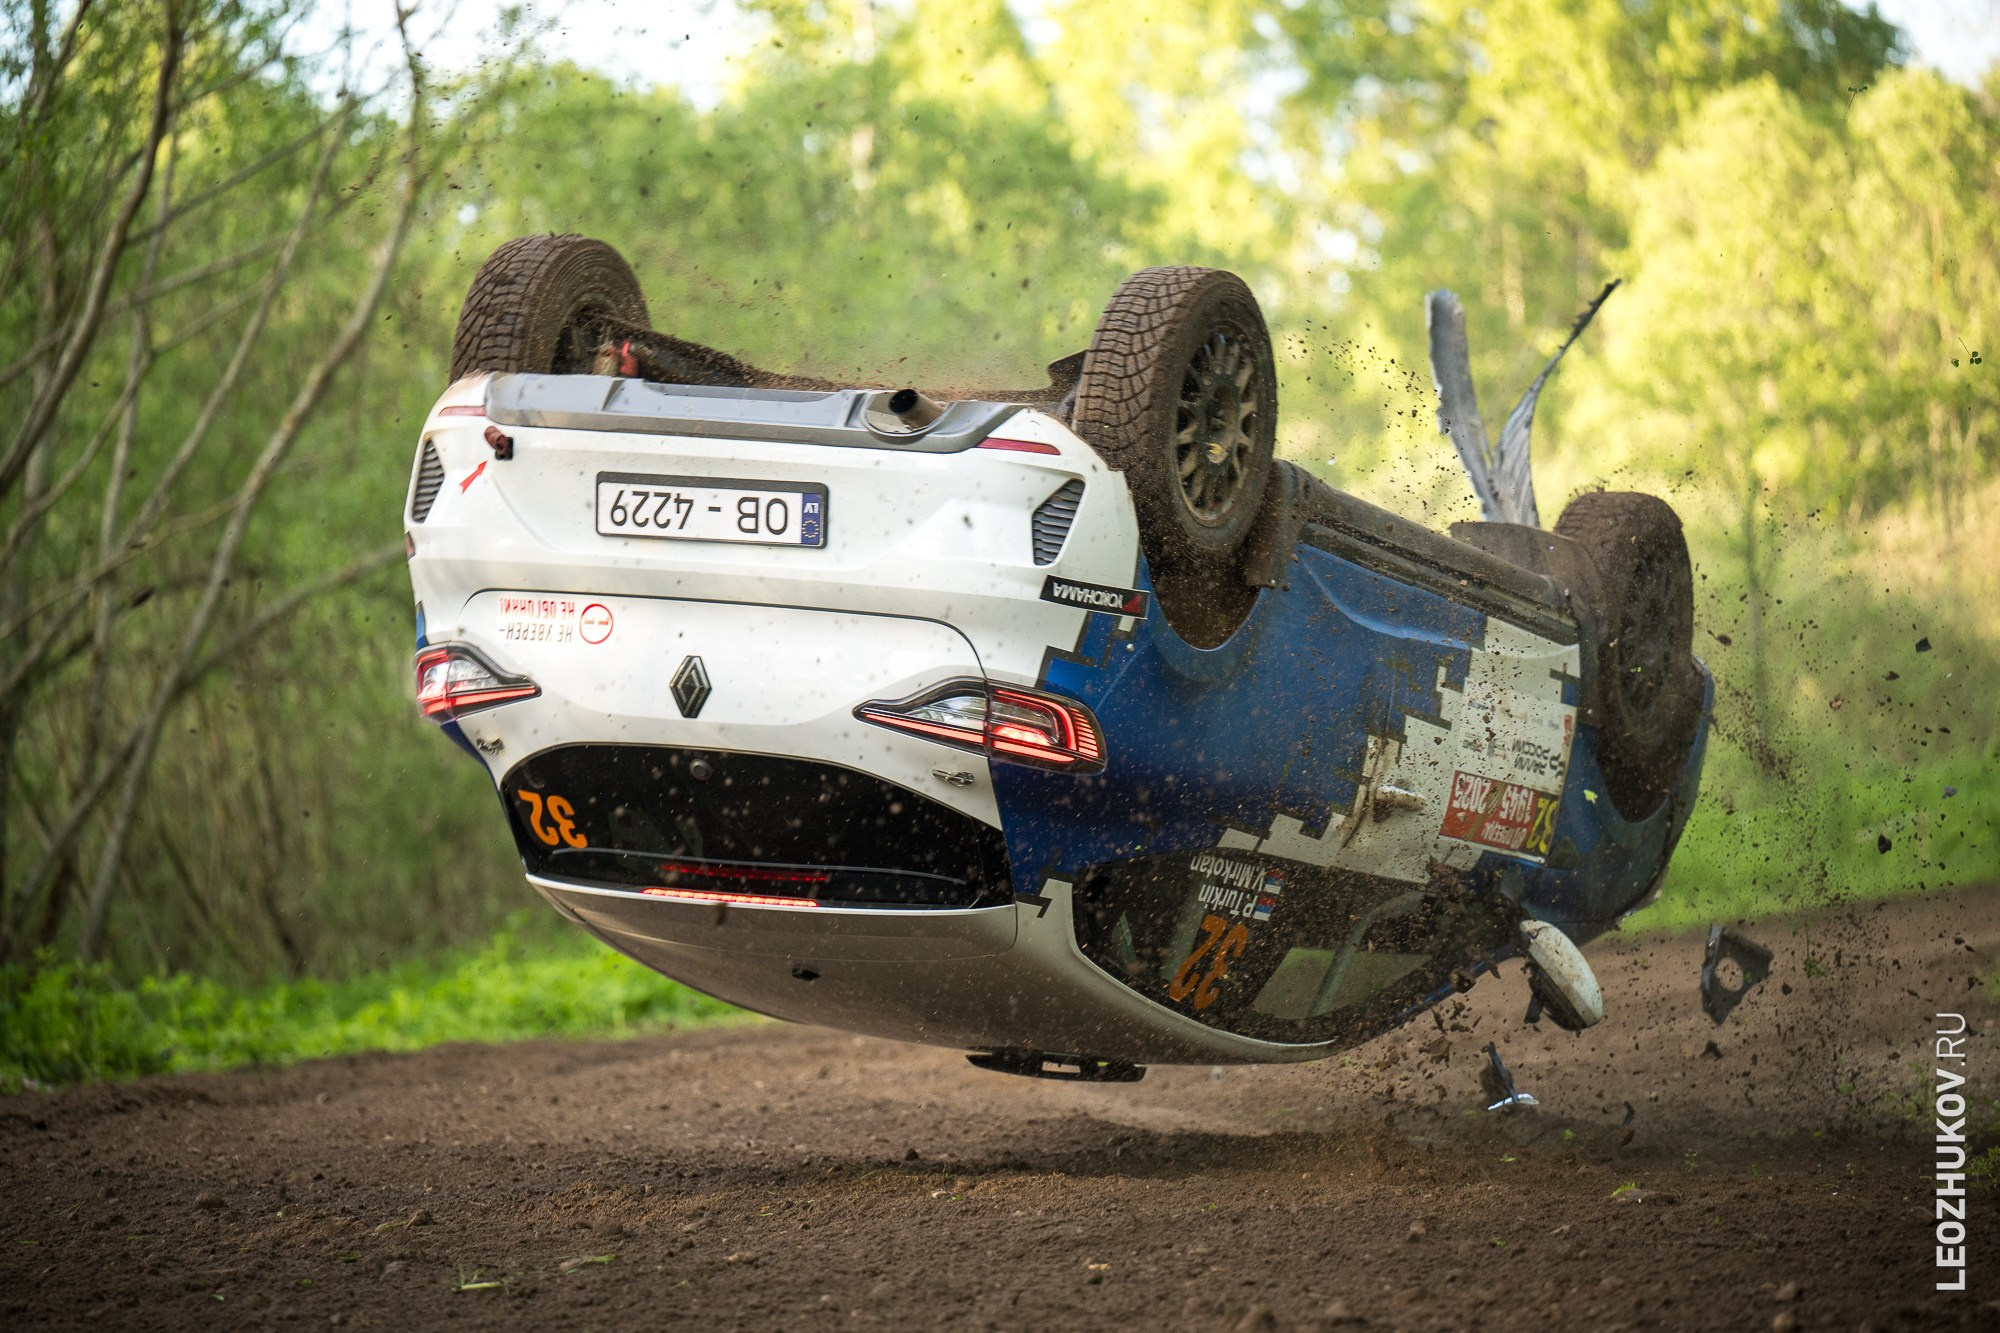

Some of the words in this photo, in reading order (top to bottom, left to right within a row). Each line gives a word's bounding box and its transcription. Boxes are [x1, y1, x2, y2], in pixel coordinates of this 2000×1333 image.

[610, 489, 694, 529] 4229
[737, 496, 788, 535] OB
[803, 501, 819, 514] LV
[560, 600, 575, 619] НЕ
[1053, 581, 1123, 608] YOKOHAMA
[557, 624, 573, 643] НЕ
[1452, 773, 1491, 814] 2025
[1499, 785, 1535, 824] 1945
[517, 789, 588, 849] 32
[1526, 797, 1559, 853] 32
[1190, 855, 1265, 891] V.Mirkotan
[1198, 884, 1258, 918] P.Turkin
[1169, 914, 1249, 1010] 32
